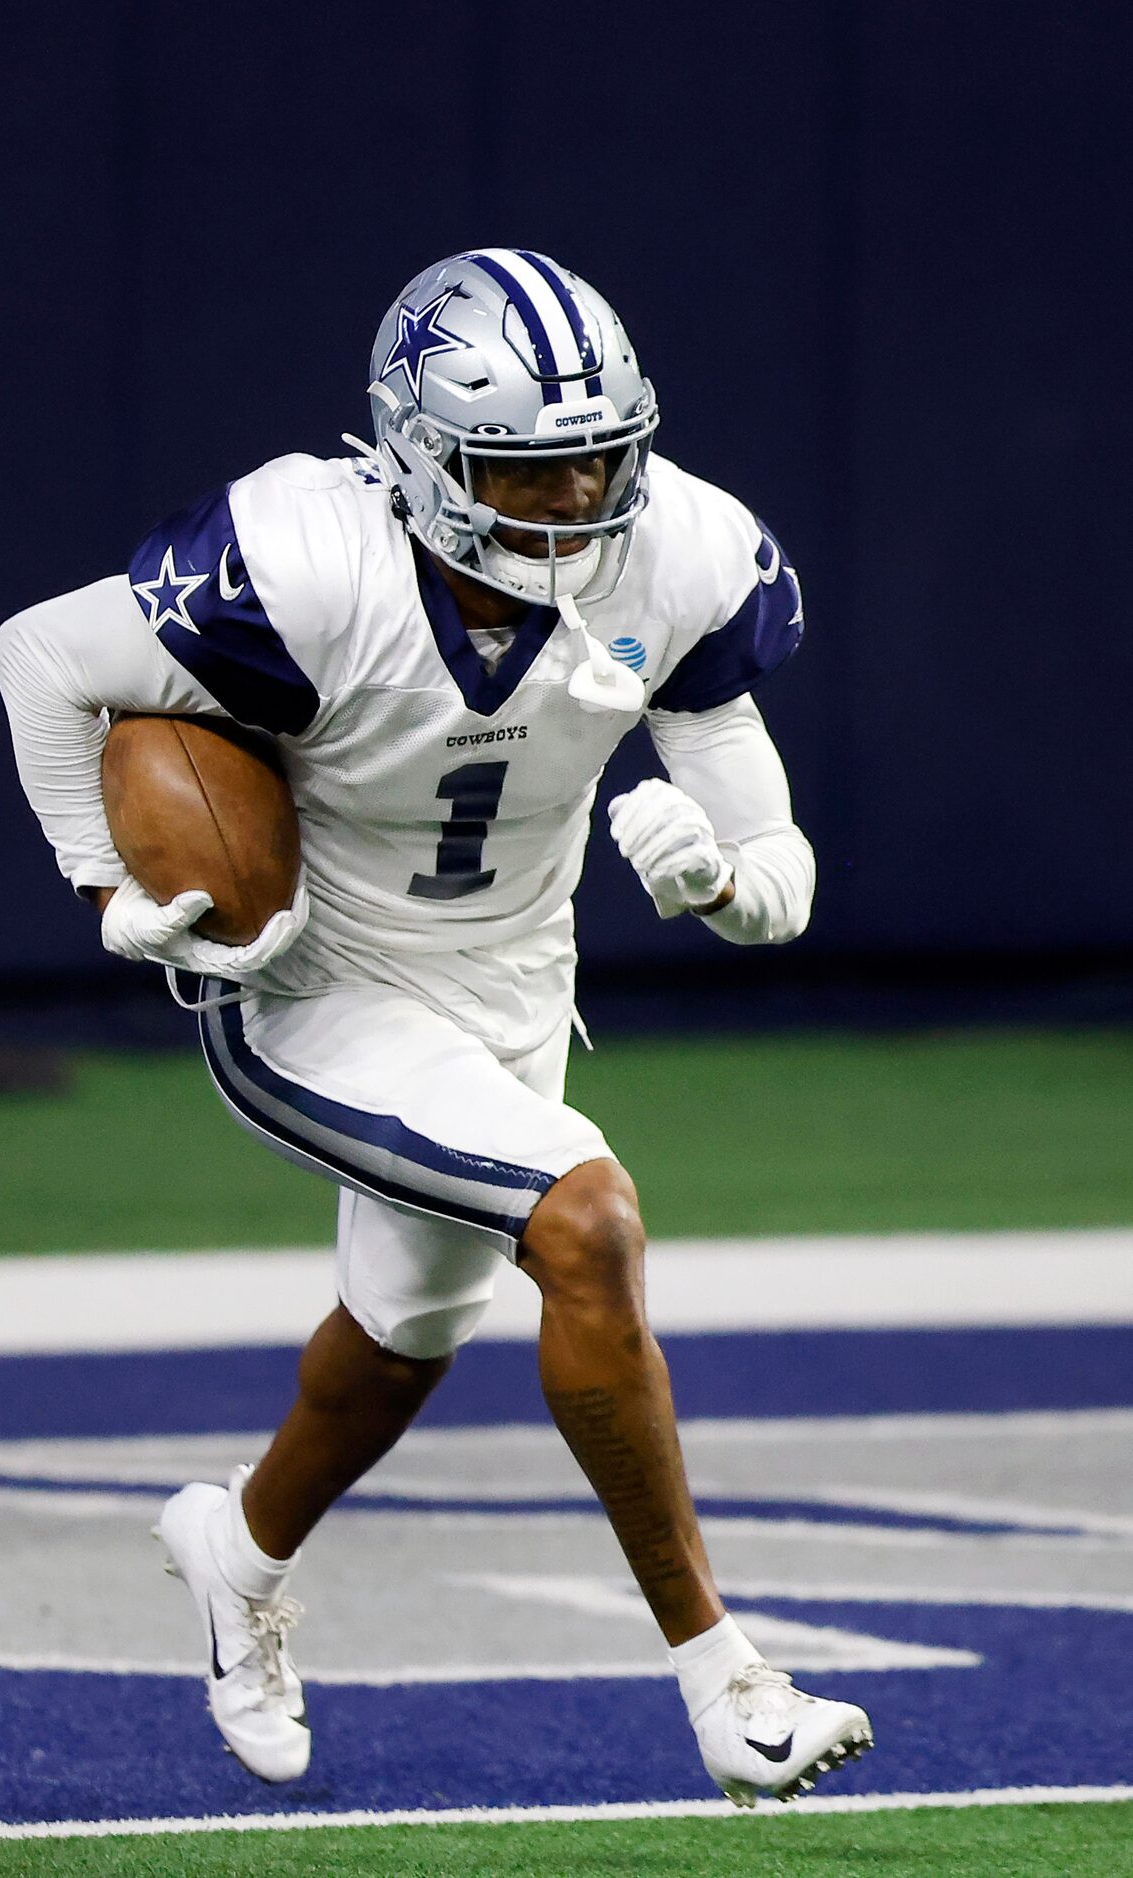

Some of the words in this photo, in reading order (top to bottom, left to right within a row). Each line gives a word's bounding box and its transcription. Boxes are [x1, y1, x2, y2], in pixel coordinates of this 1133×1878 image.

[555, 411, 603, 427] COWBOYS
[446, 726, 528, 747] COWBOYS
[406, 760, 509, 900] 1
